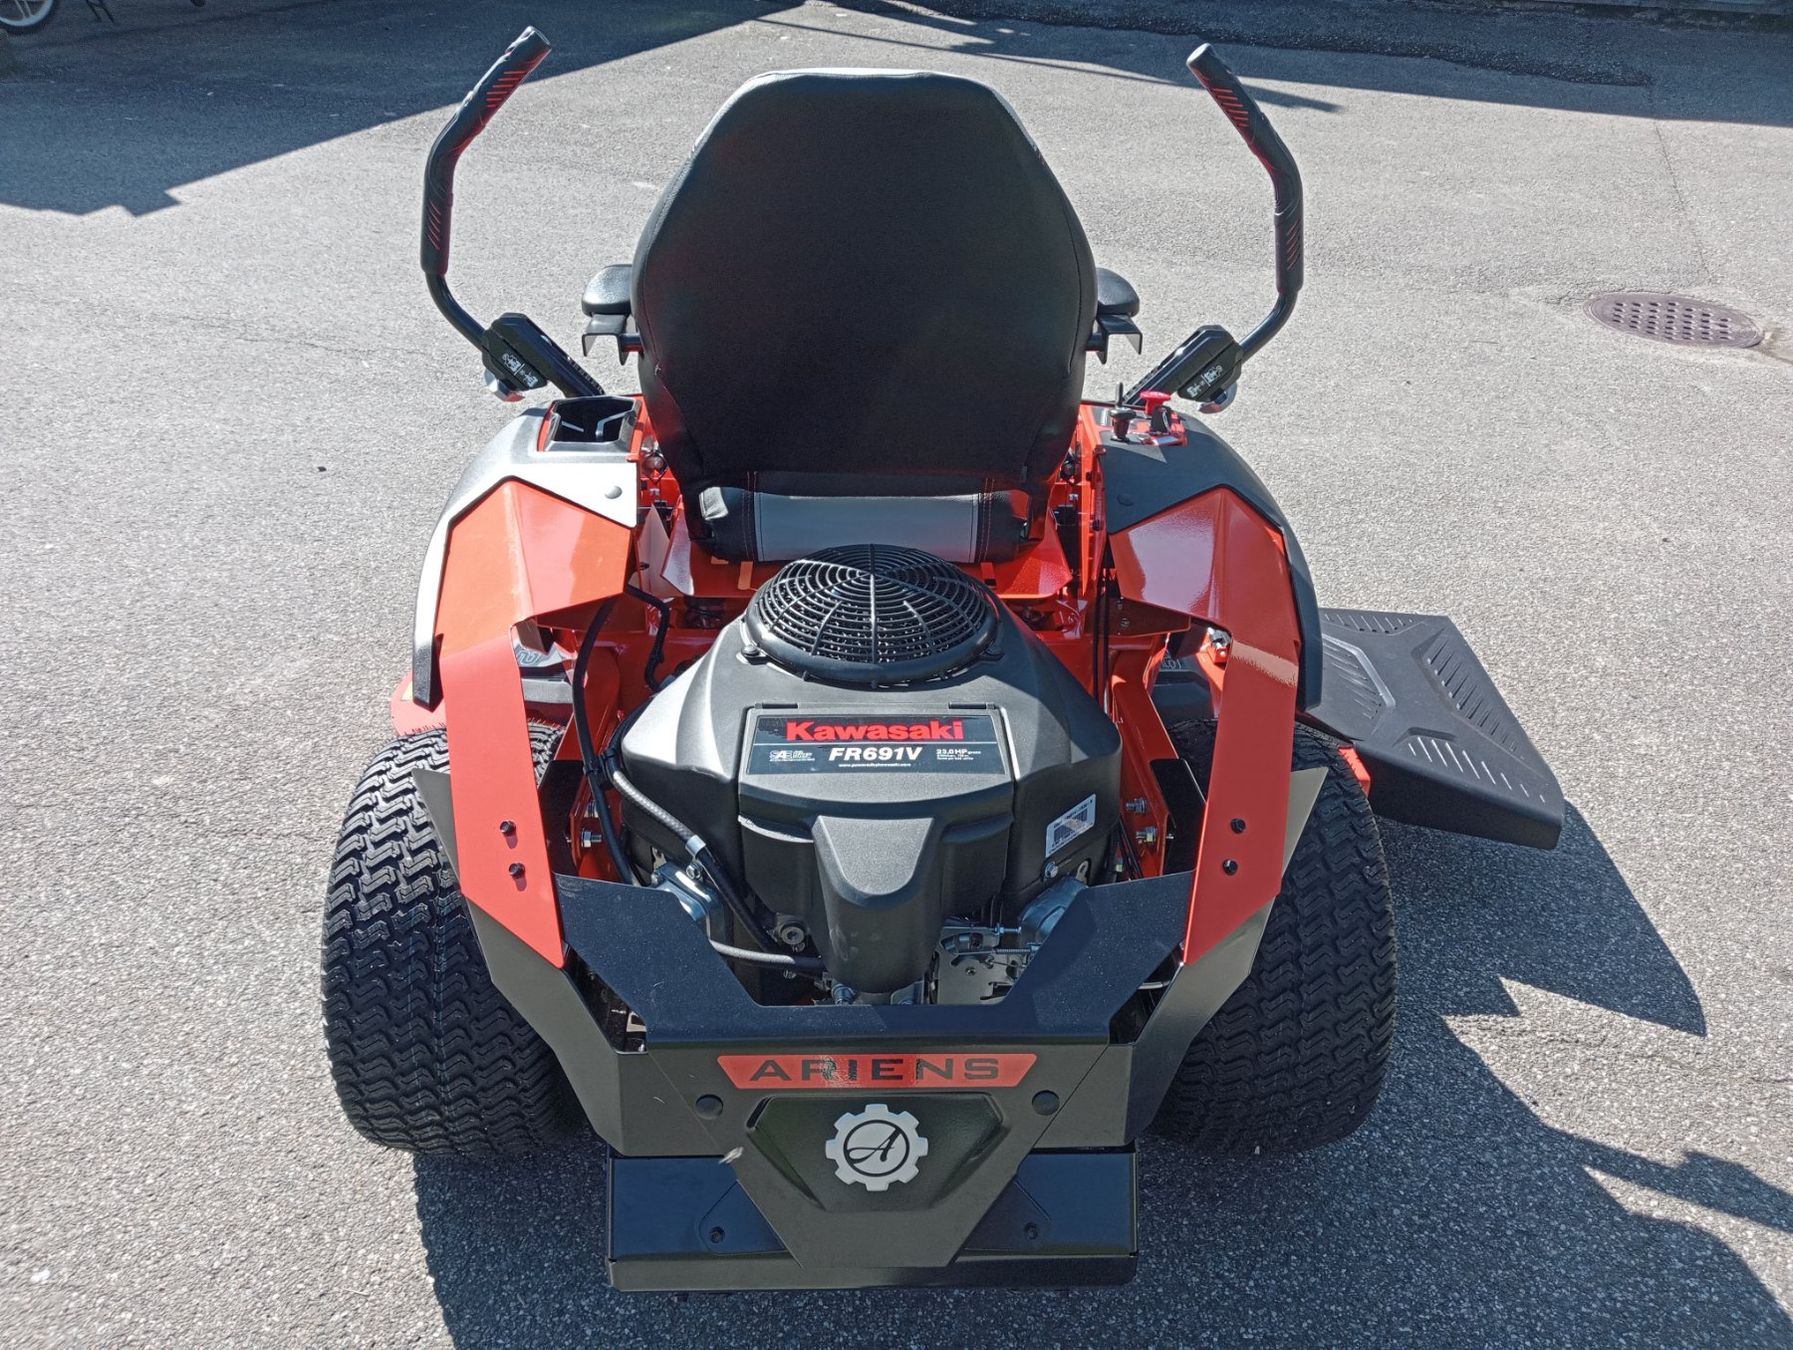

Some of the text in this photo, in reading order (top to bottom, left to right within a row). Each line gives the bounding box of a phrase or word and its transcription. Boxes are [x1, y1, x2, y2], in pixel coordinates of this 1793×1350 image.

[786, 720, 964, 741] Kawasaki
[828, 746, 923, 761] FR691V
[750, 1058, 999, 1081] ARIENS
